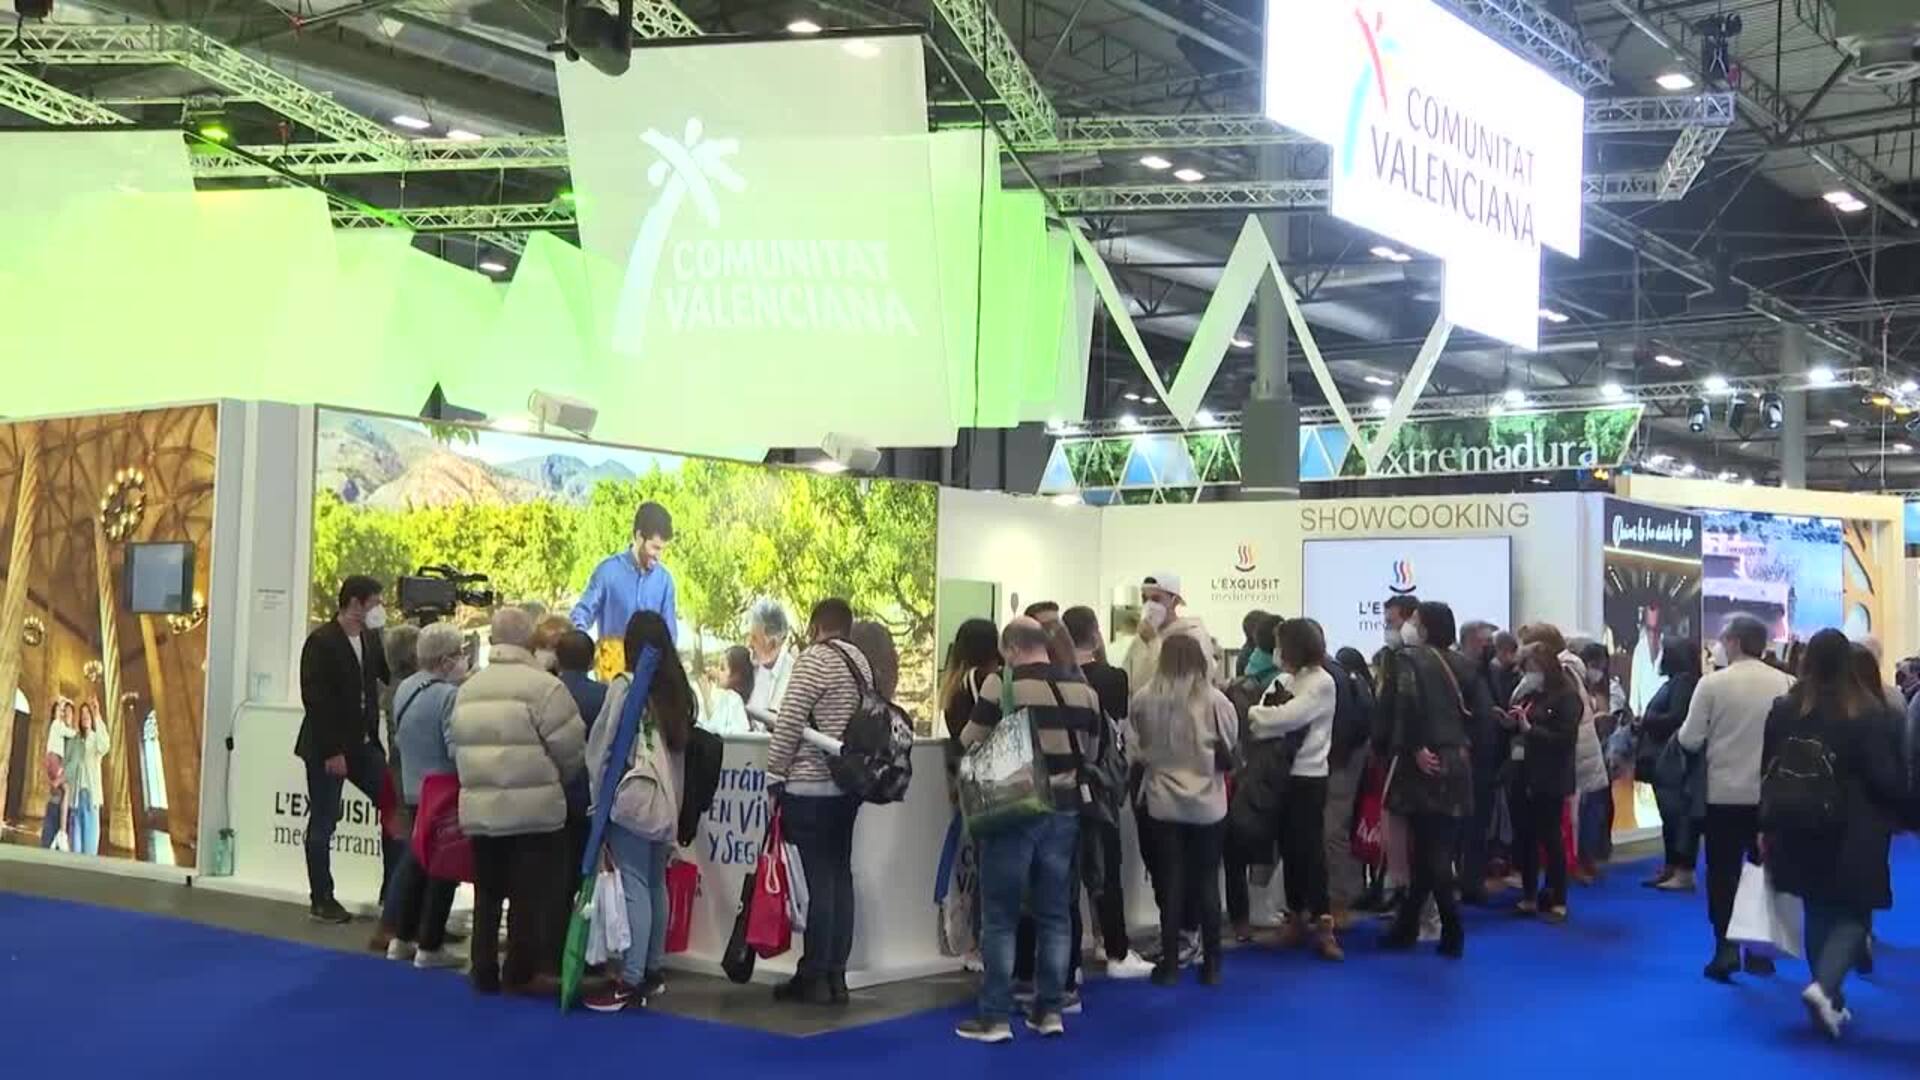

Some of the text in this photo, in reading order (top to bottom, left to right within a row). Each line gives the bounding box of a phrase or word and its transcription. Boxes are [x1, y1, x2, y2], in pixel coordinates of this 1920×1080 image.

[1407, 87, 1534, 187] COMUNITAT
[1371, 125, 1536, 247] VALENCIANA
[672, 239, 890, 281] COMUNITAT
[662, 285, 920, 336] VALENCIANA
[1382, 432, 1600, 475] xtremadura
[1300, 501, 1530, 532] SHOWCOOKING
[1210, 578, 1280, 591] L'EXQUISIT
[709, 798, 731, 823] EN
[708, 831, 719, 862] Y
